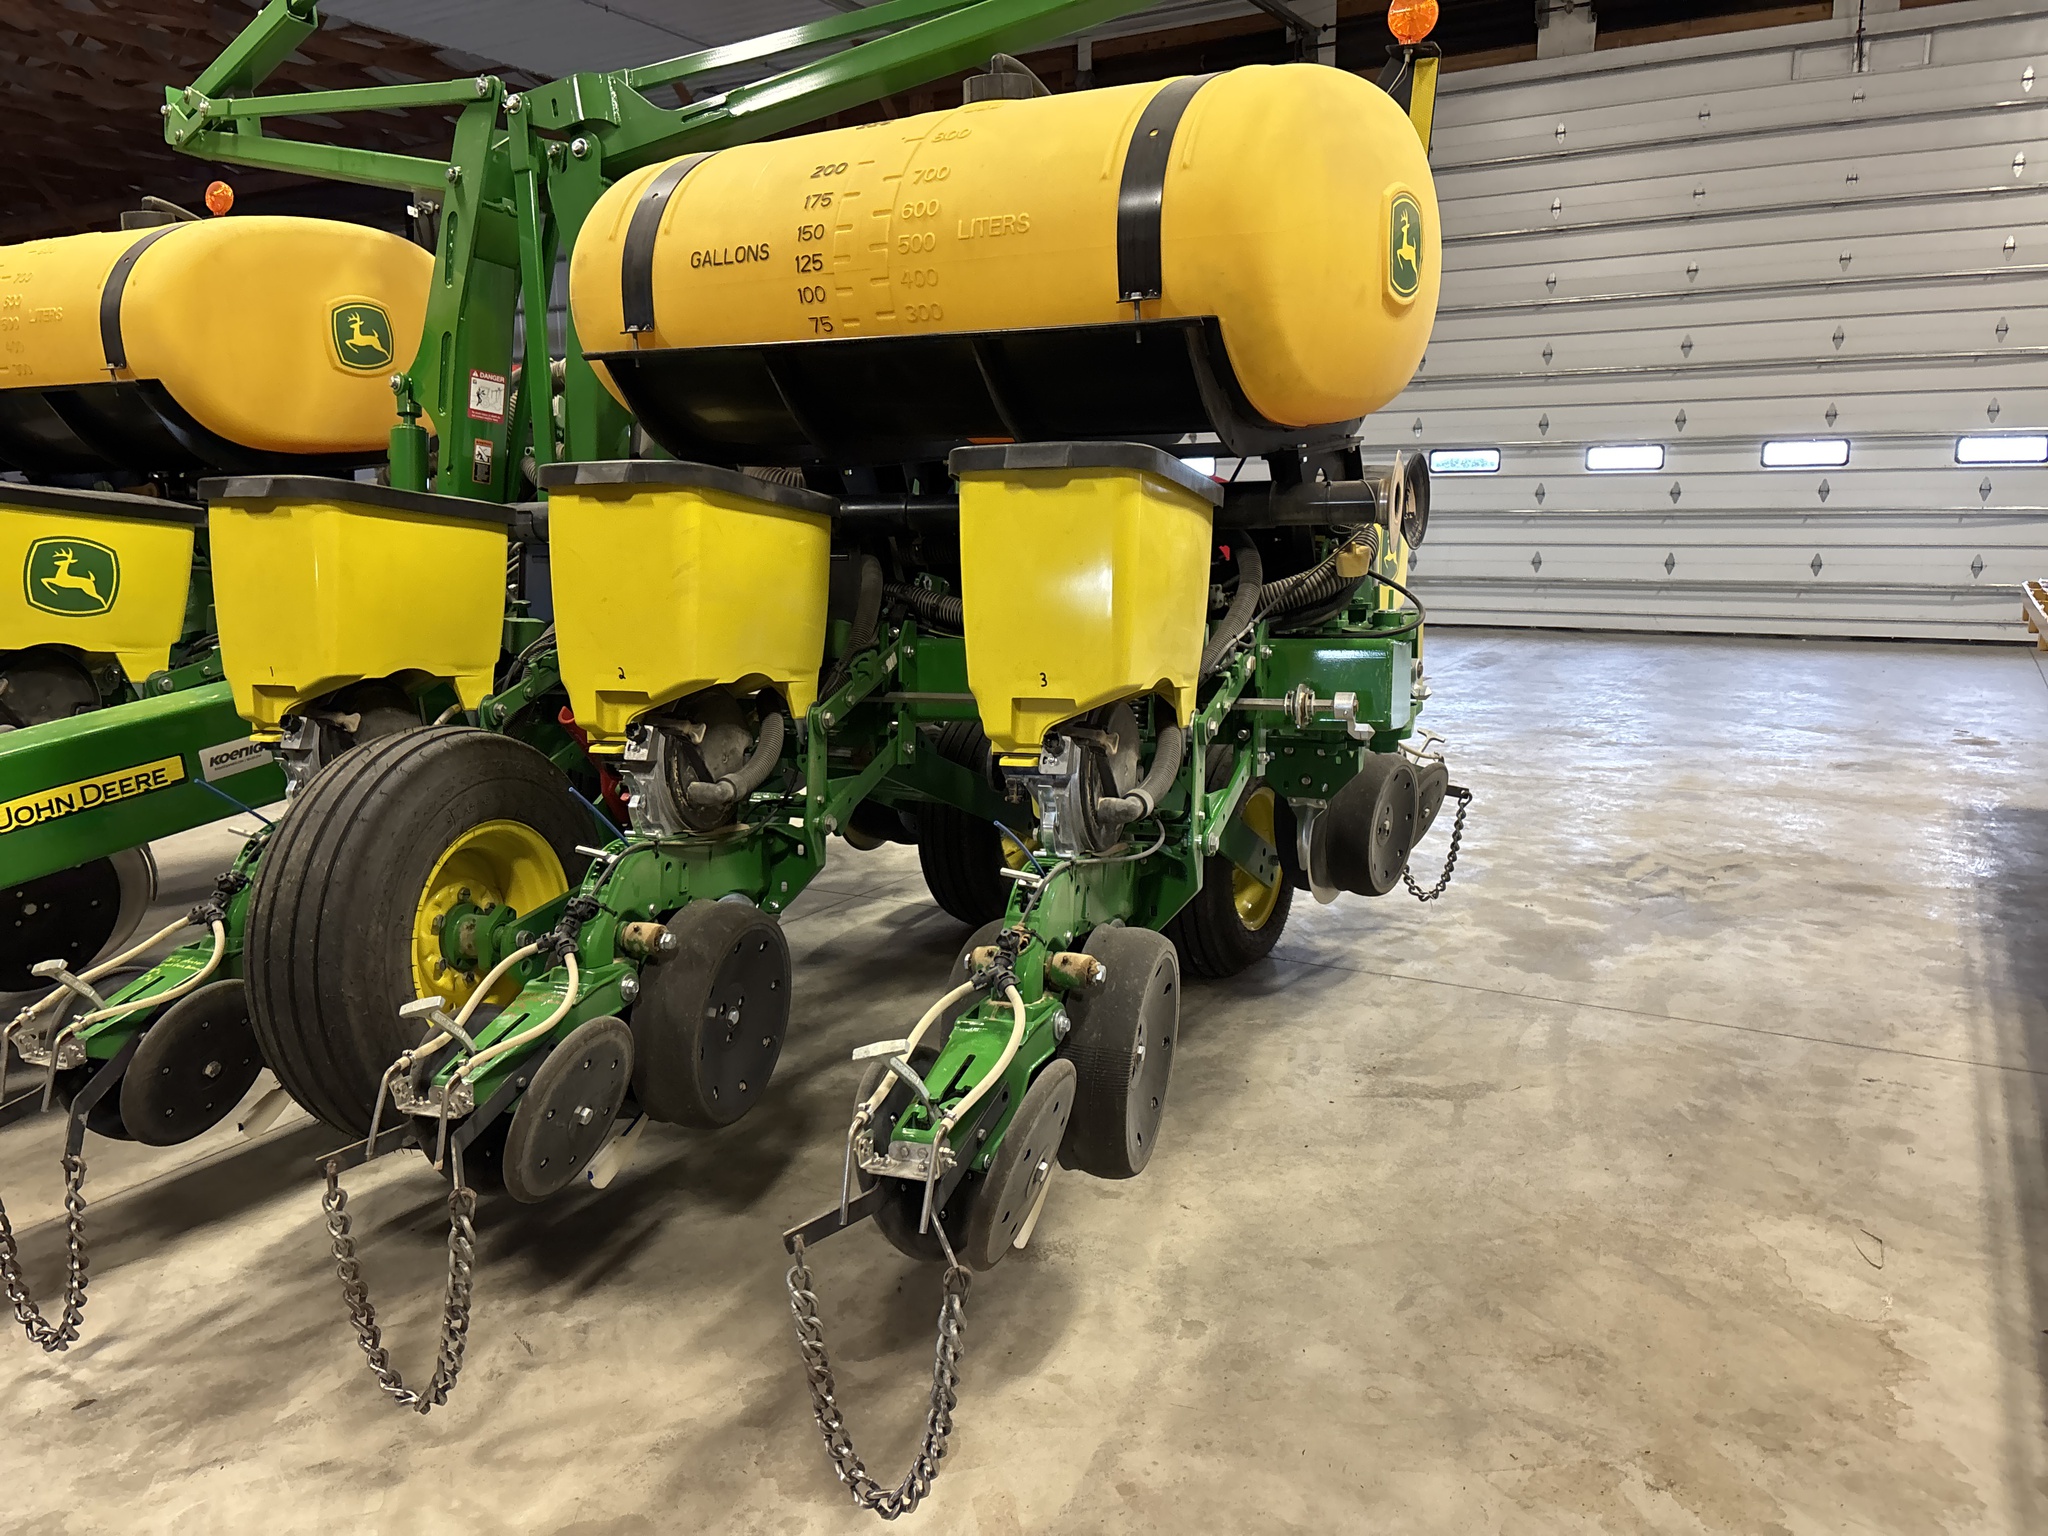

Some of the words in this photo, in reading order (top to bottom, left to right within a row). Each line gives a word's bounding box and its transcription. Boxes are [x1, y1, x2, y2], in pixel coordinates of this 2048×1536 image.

[810, 161, 848, 179] 200
[913, 166, 951, 185] 700
[803, 191, 834, 210] 175
[901, 199, 940, 219] 600
[797, 223, 825, 242] 150
[957, 212, 1031, 241] LITERS
[897, 232, 936, 255] 500
[690, 242, 770, 269] GALLONS
[795, 253, 823, 274] 125
[900, 268, 938, 288] 400
[797, 285, 826, 304] 100
[904, 303, 943, 323] 300
[808, 316, 834, 333] 75
[479, 371, 505, 383] DANGER
[617, 666, 627, 680] 2
[1039, 671, 1048, 688] 3
[0, 793, 75, 830] JOHN
[79, 767, 169, 806] DEERE
